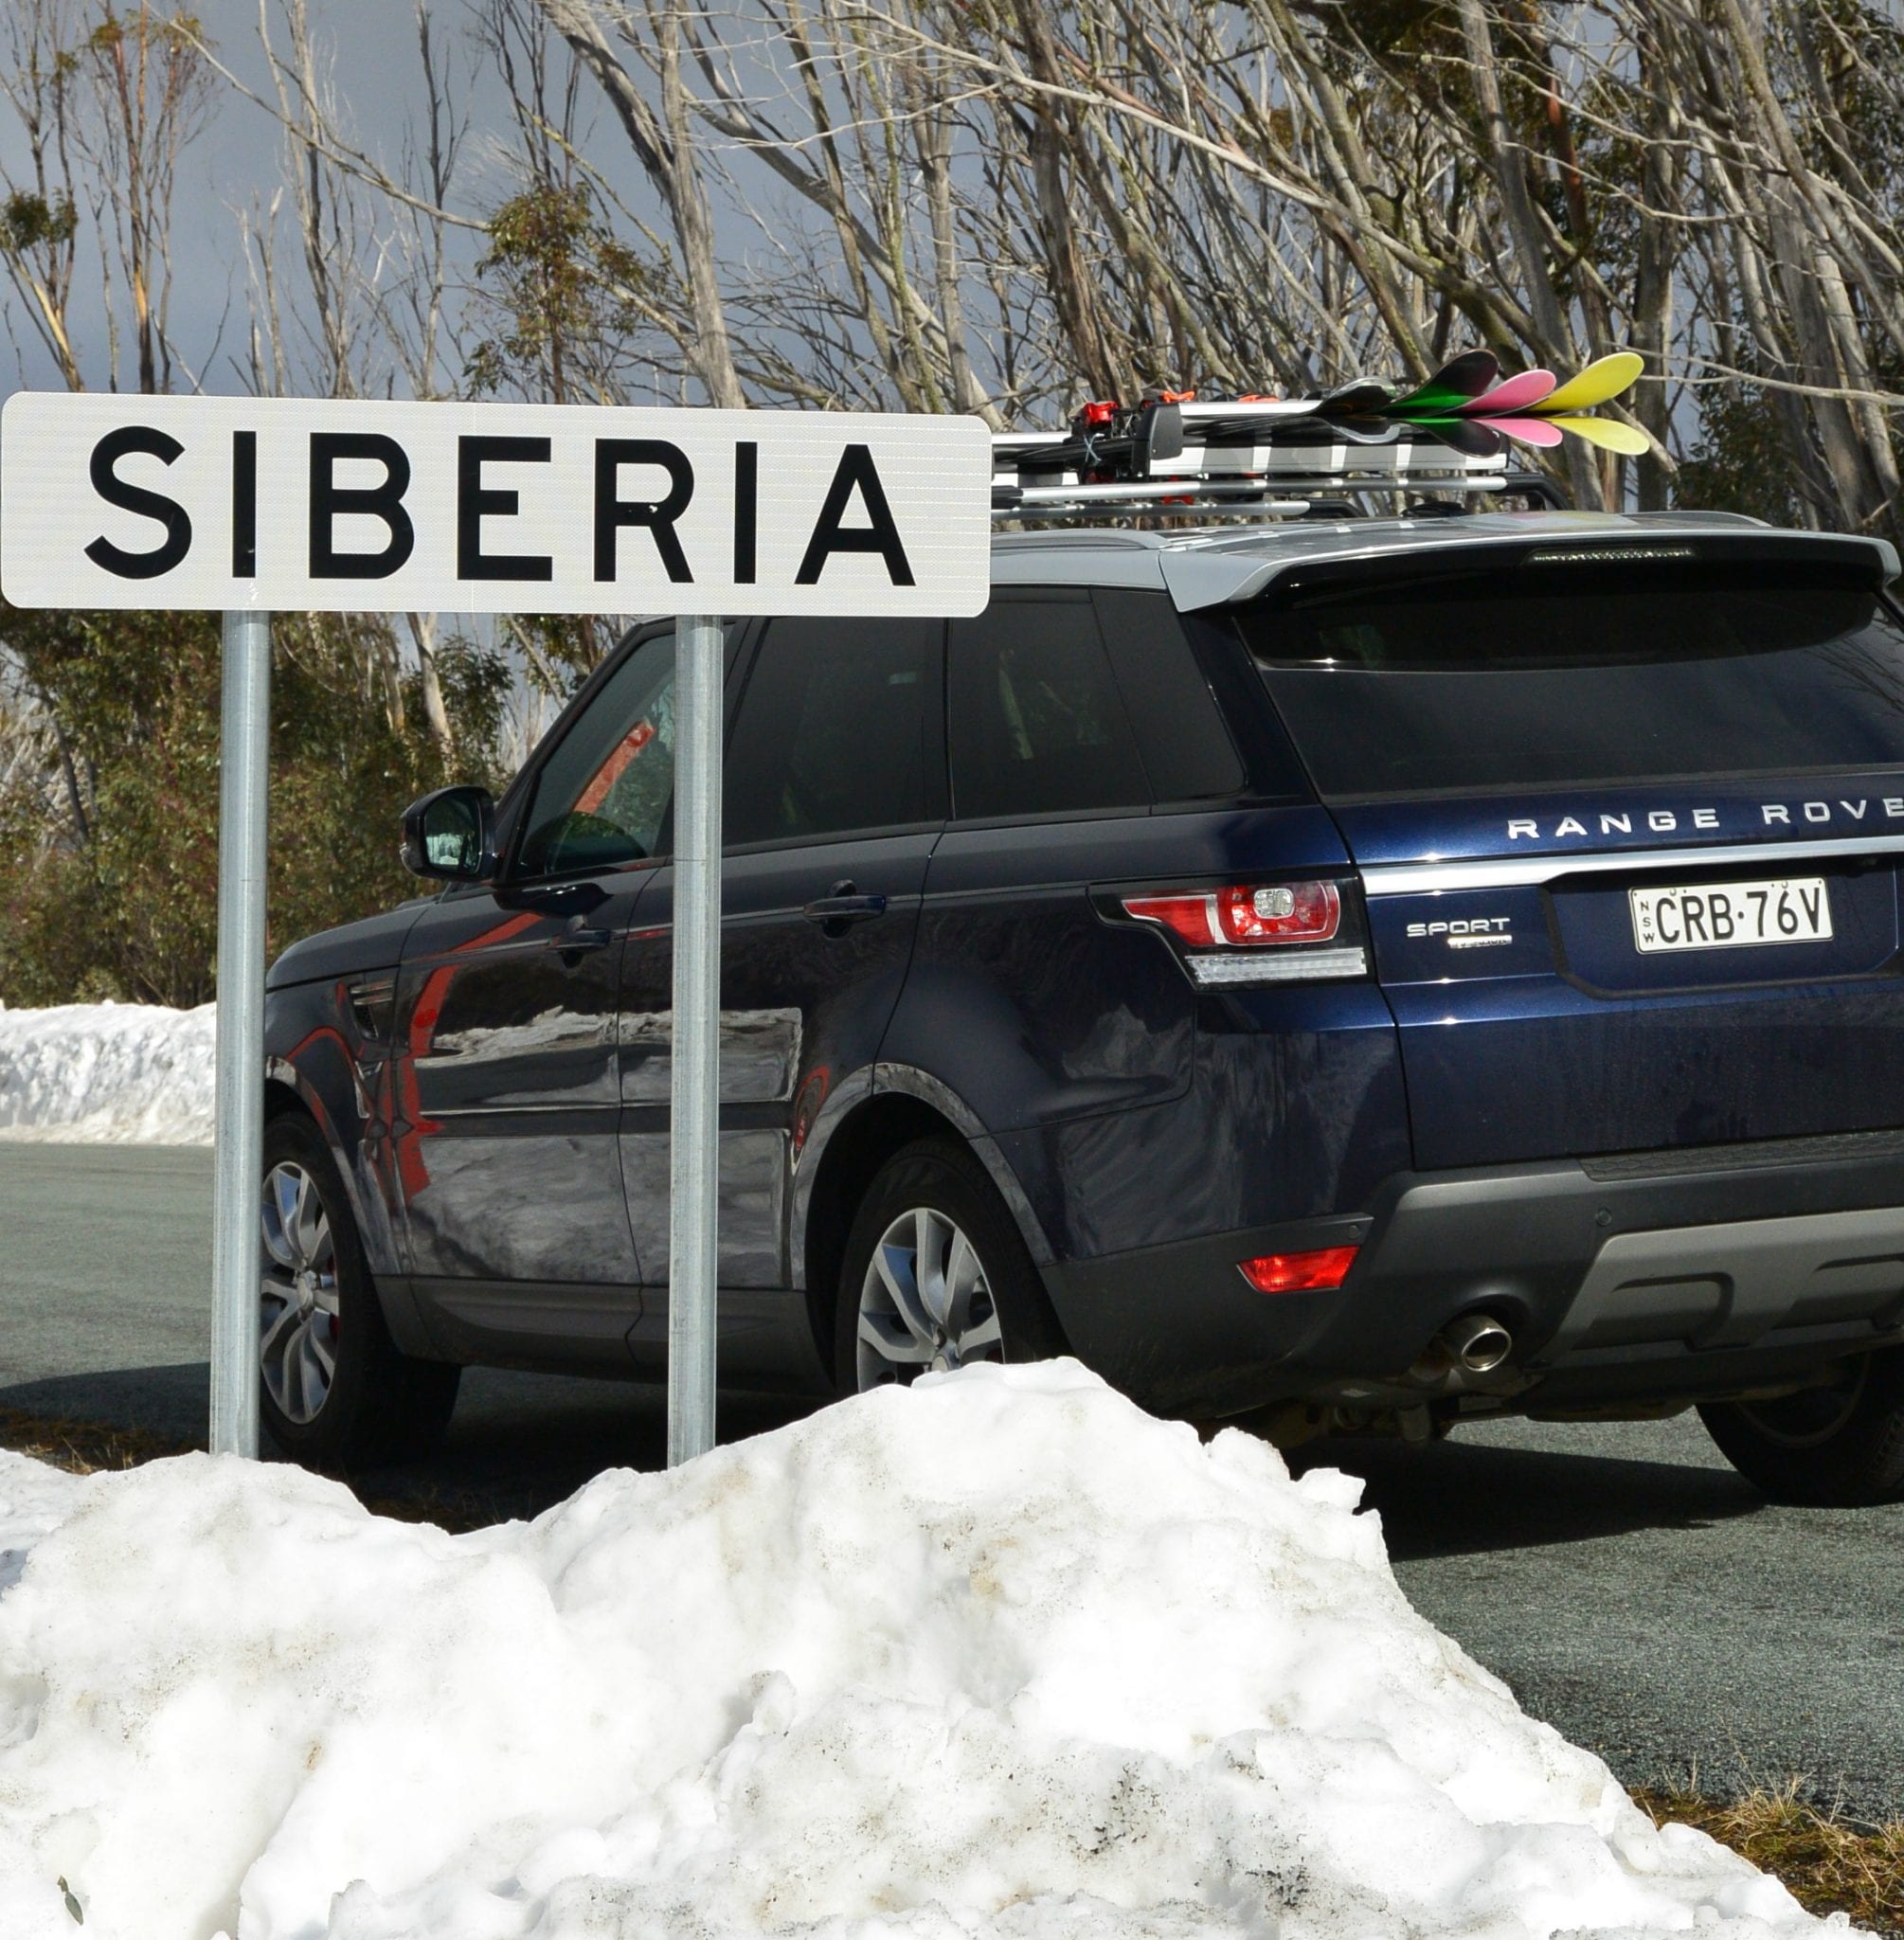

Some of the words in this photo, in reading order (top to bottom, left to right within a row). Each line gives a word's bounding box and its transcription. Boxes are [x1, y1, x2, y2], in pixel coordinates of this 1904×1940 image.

[83, 425, 917, 587] SIBERIA
[1507, 808, 1720, 839] RANGE
[1406, 917, 1511, 938] SPORT
[1640, 901, 1655, 943] NSW
